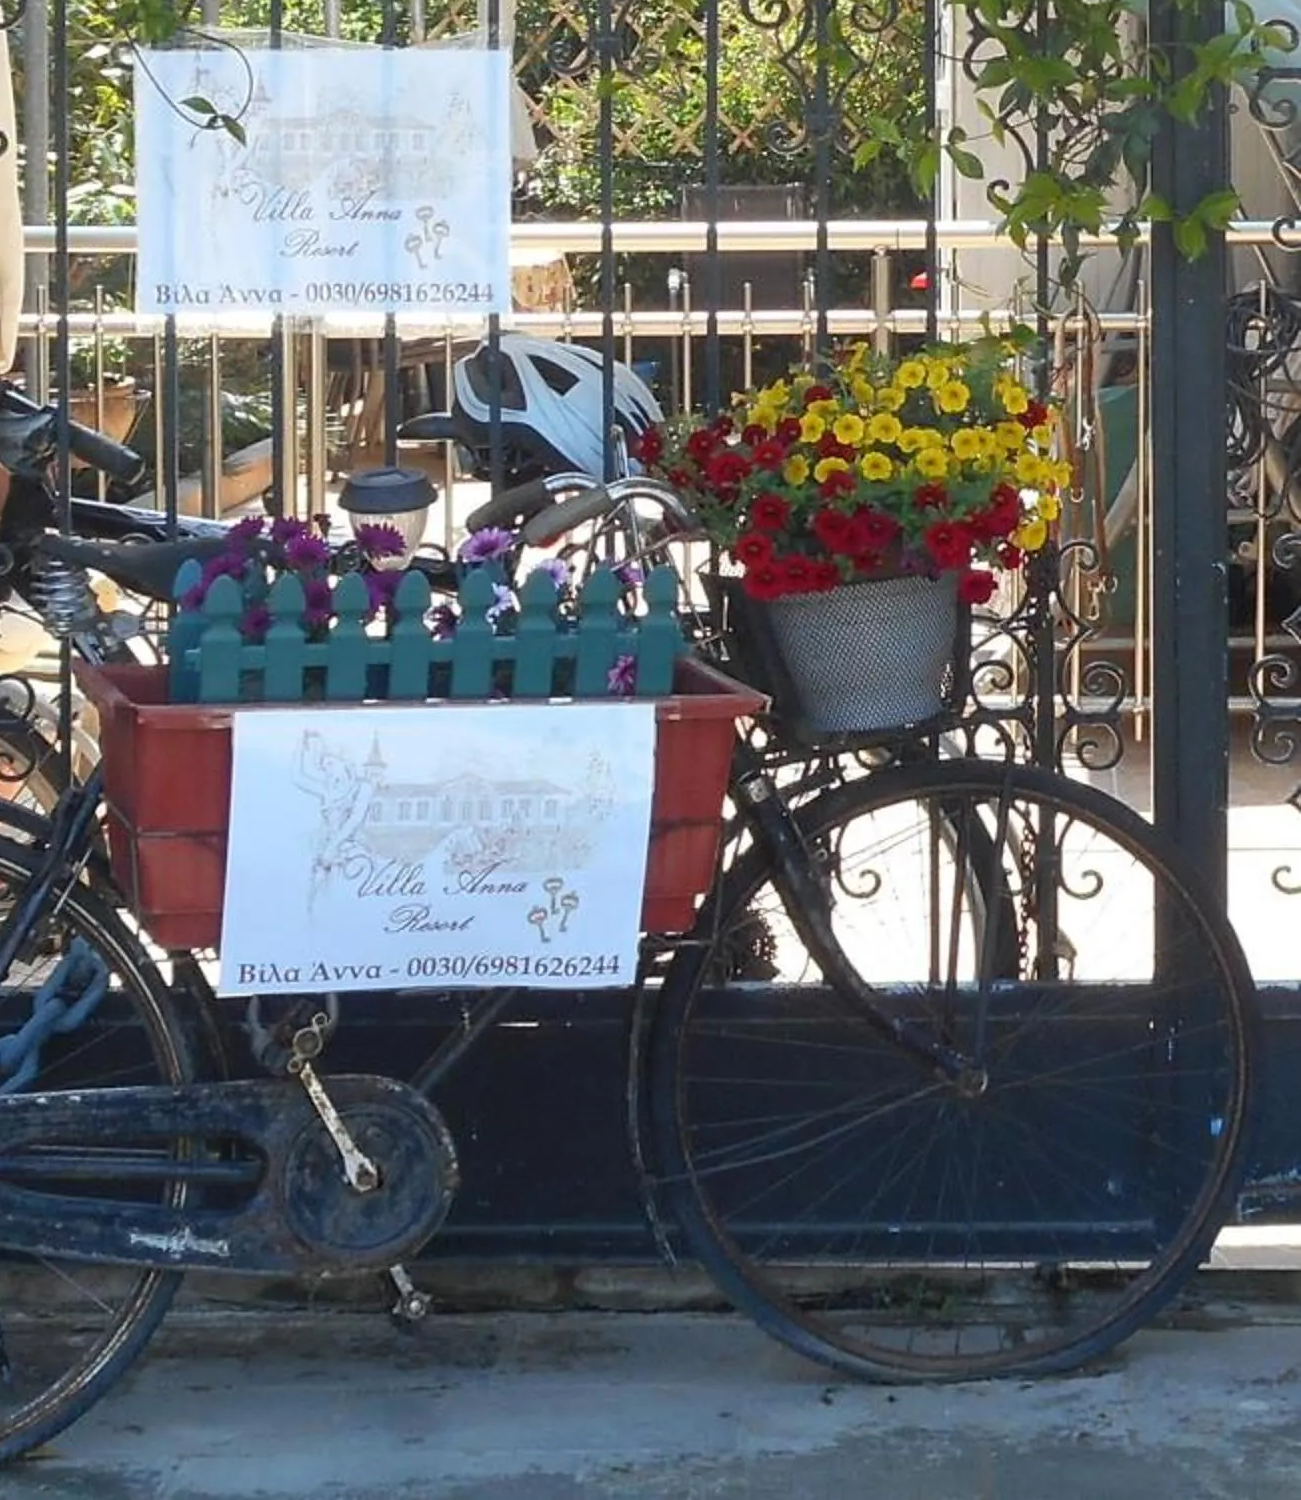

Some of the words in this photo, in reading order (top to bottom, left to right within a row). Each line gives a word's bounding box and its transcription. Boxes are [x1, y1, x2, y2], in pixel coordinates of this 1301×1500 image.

[239, 180, 316, 222] Villa
[328, 186, 403, 222] Anna
[279, 226, 359, 260] Resort
[306, 282, 494, 306] 0030/6981626244
[341, 852, 428, 897] Villa
[443, 856, 529, 895] Anna
[383, 904, 475, 936] Resort
[238, 961, 301, 985] Βίλα
[312, 961, 382, 982] Άννα
[406, 956, 620, 982] 0030/6981626244
